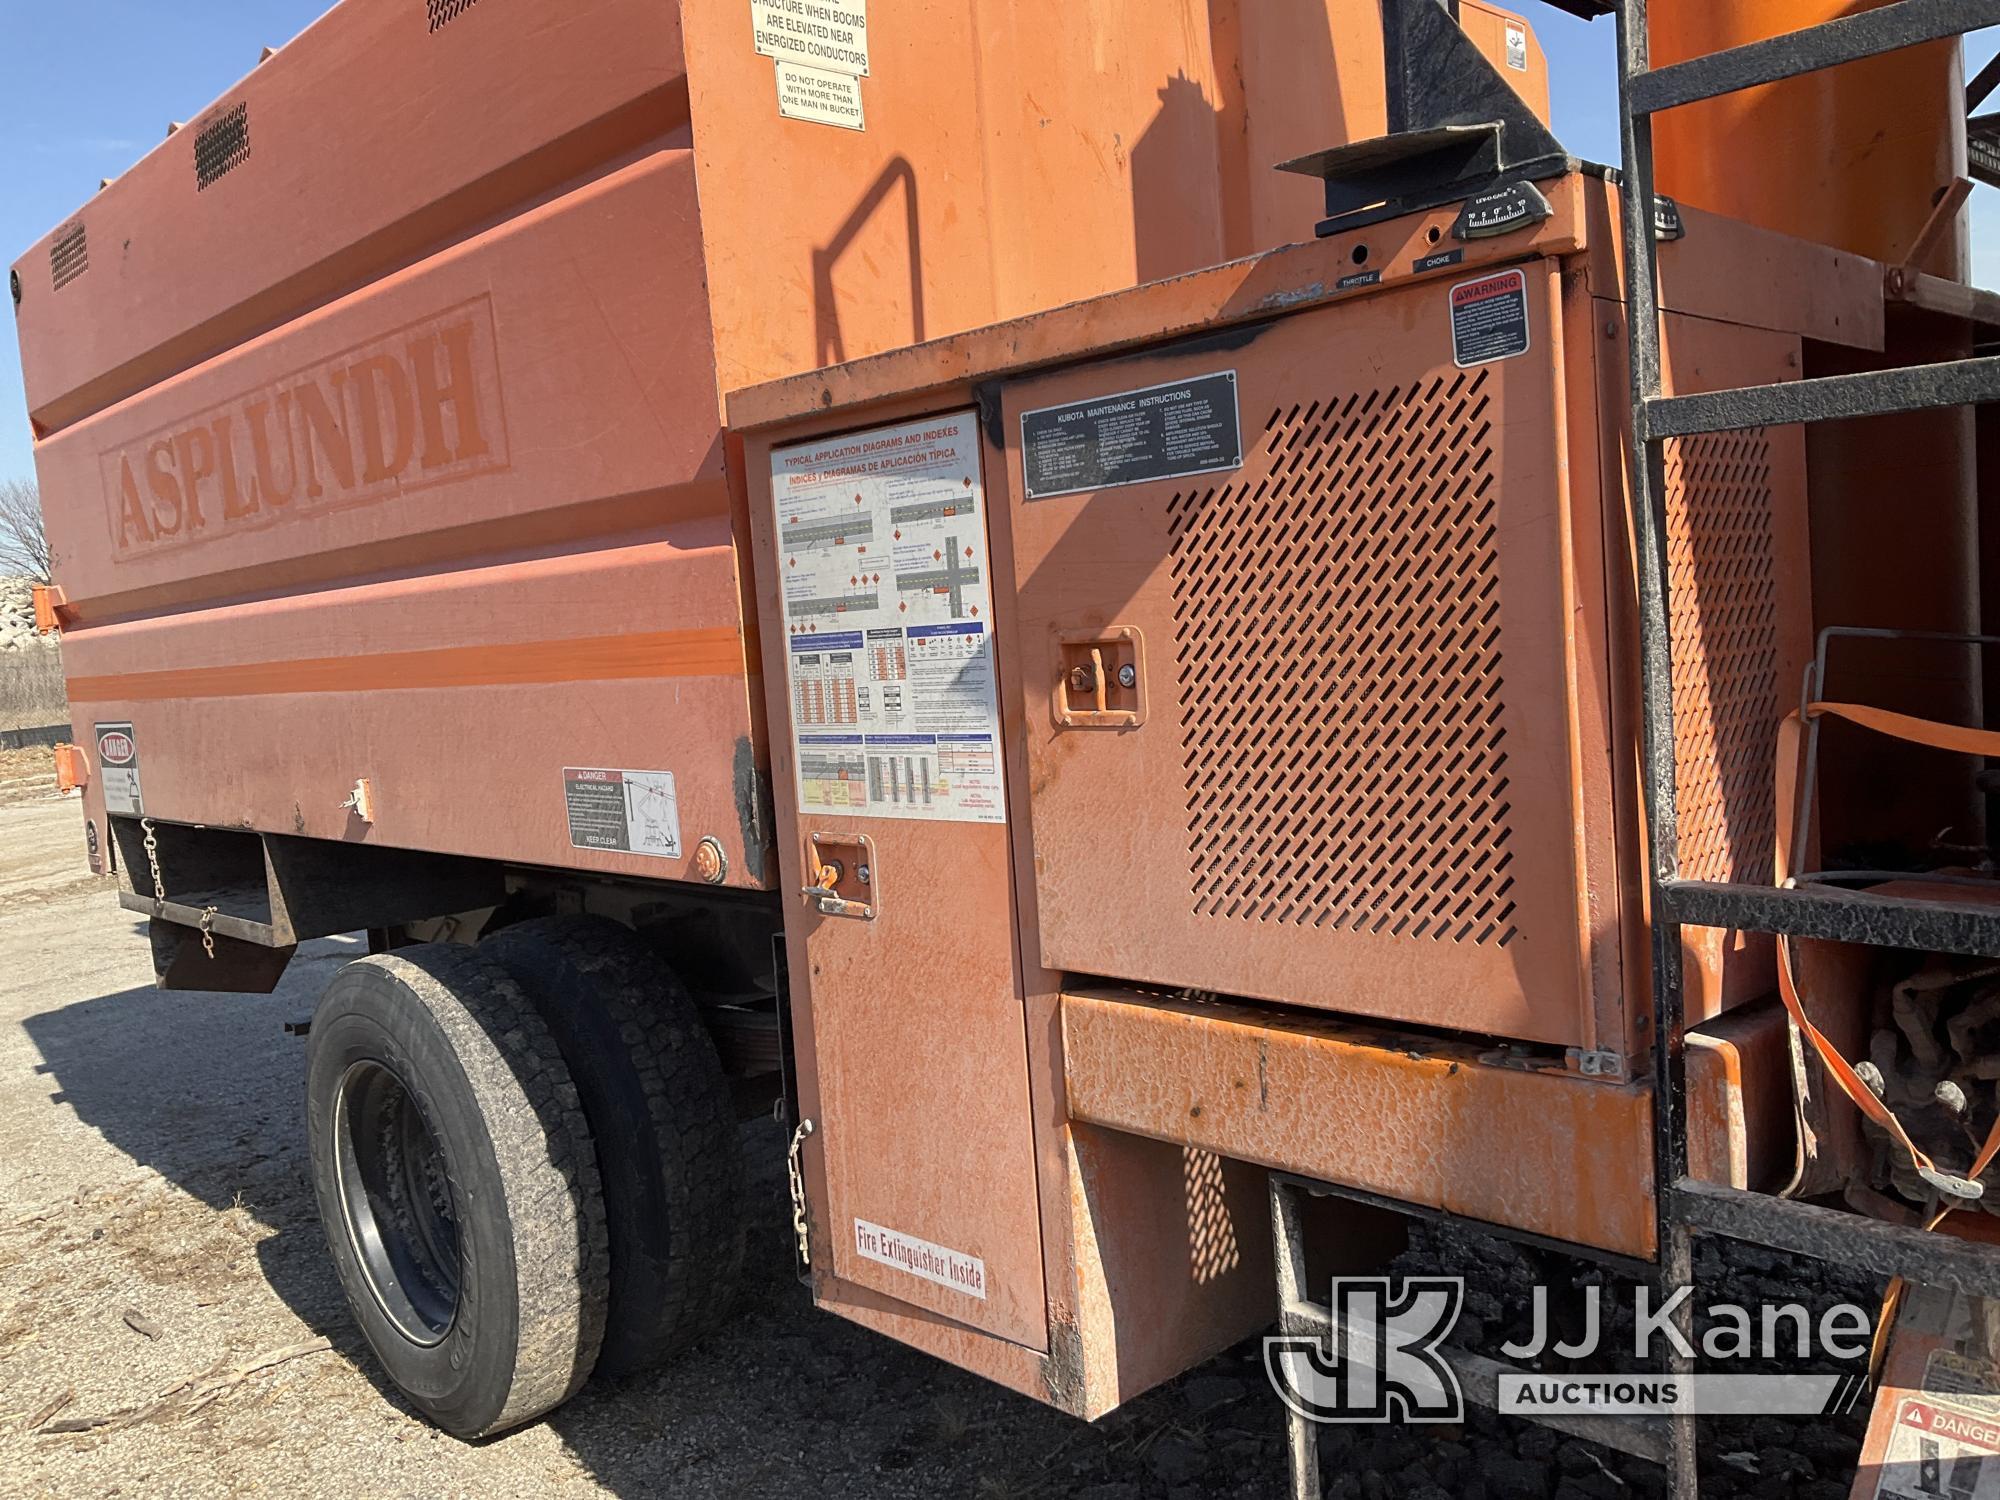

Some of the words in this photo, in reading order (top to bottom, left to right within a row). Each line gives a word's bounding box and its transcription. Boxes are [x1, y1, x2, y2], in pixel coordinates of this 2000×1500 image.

[752, 0, 803, 14] RUCTURE
[804, 3, 830, 21] WHEN
[833, 10, 865, 28] BOOMS
[766, 14, 784, 29] ARE
[786, 18, 828, 39] ELEVATED
[830, 28, 853, 45] NEAR
[756, 30, 805, 52] ENERGIZED
[808, 42, 866, 66] CONDUCTORS
[786, 73, 797, 82] DO
[799, 76, 815, 85] NOT
[817, 80, 852, 93] OPERATE
[787, 85, 806, 95] WITH
[808, 89, 830, 100] MORE
[832, 94, 853, 104] THAN
[782, 95, 799, 105] ONE
[800, 99, 818, 108] MAN
[830, 105, 859, 116] BUCKET
[1426, 255, 1450, 267] CHOKE
[1343, 274, 1374, 286] THROTTLE
[1463, 277, 1517, 297] WARNING
[1057, 411, 1084, 423] KUBOTA
[1087, 401, 1136, 418] MAINTENANCE
[1139, 390, 1191, 408] INSTRUCTIONS
[117, 321, 491, 549] ASPLUNDH
[784, 455, 813, 467] TYPICAL
[815, 445, 861, 461] APPLICATION
[863, 437, 902, 453] DIAGRAMS
[904, 433, 922, 444] AND
[923, 426, 958, 441] INDEXES
[824, 462, 867, 479] DIAGRAMAS
[868, 461, 878, 471] DE
[880, 453, 927, 468] APLICACIÓN
[582, 771, 606, 780] DANGER
[858, 1226, 876, 1252] Fire
[880, 1233, 945, 1277] Extinguisher
[950, 1256, 981, 1289] Inside
[1932, 1414, 2000, 1444] DANGE
